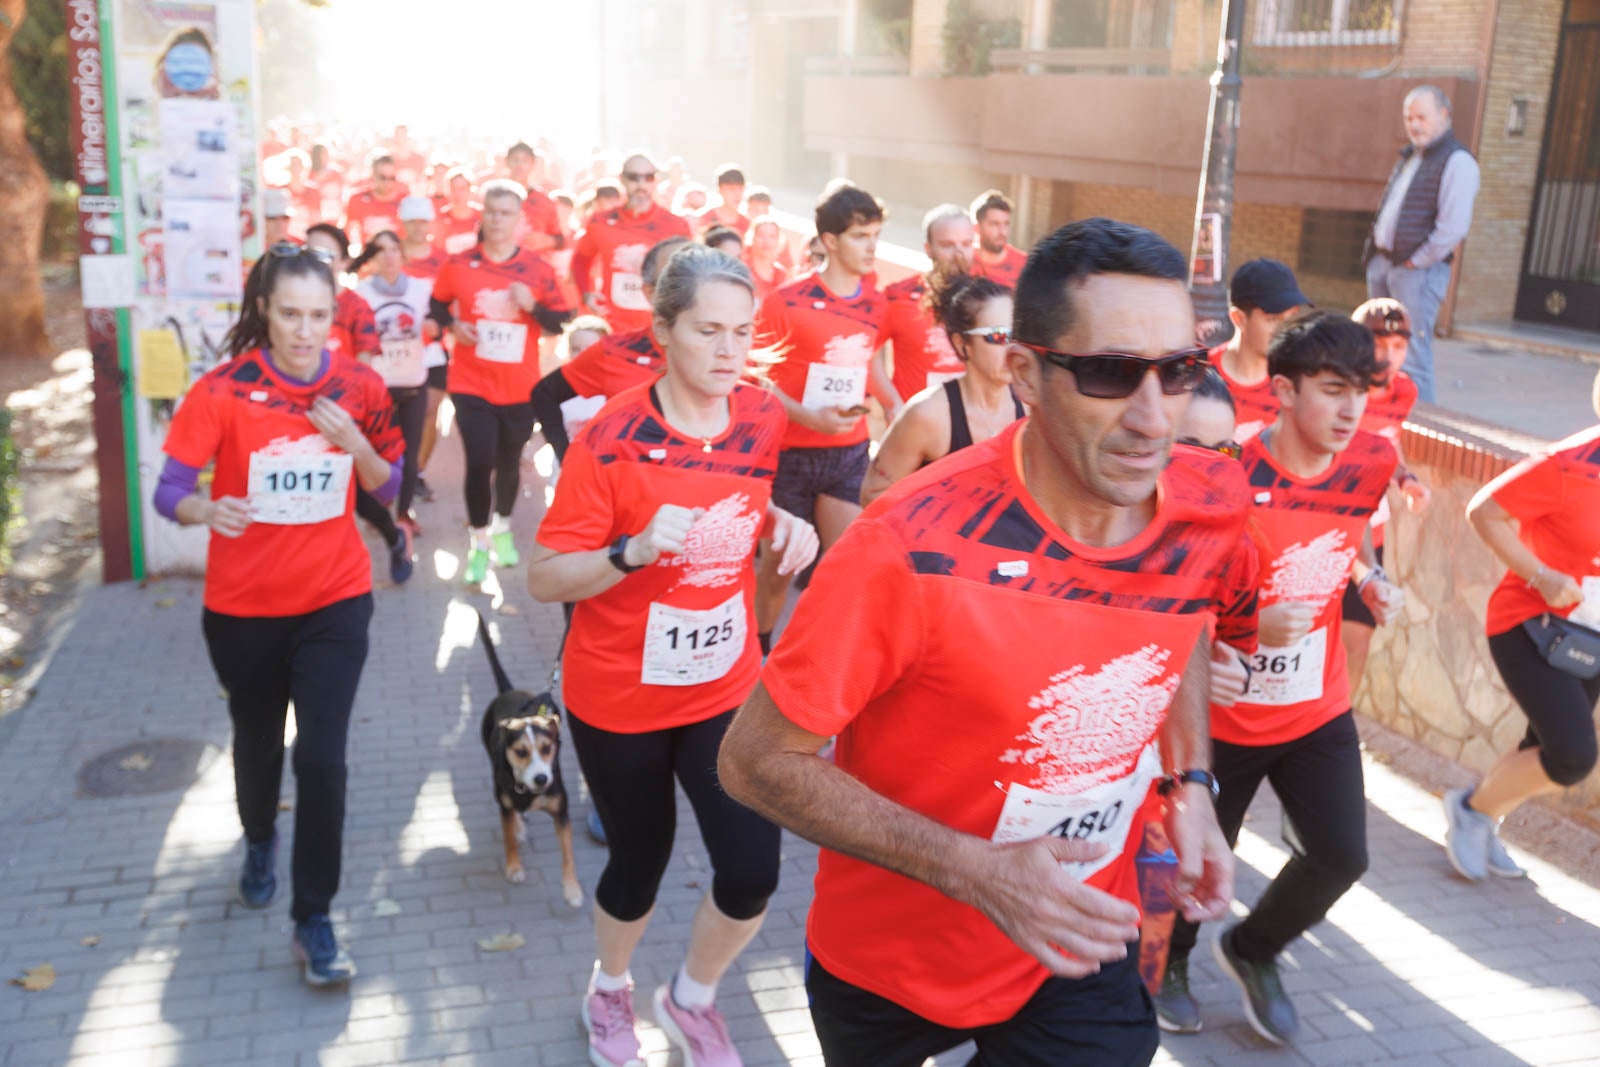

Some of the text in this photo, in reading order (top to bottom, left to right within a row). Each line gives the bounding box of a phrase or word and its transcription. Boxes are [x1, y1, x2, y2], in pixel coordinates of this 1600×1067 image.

[823, 376, 854, 393] 205
[266, 470, 333, 493] 1017
[665, 618, 733, 650] 1125
[1252, 652, 1302, 674] 361
[1047, 799, 1123, 840] 480
